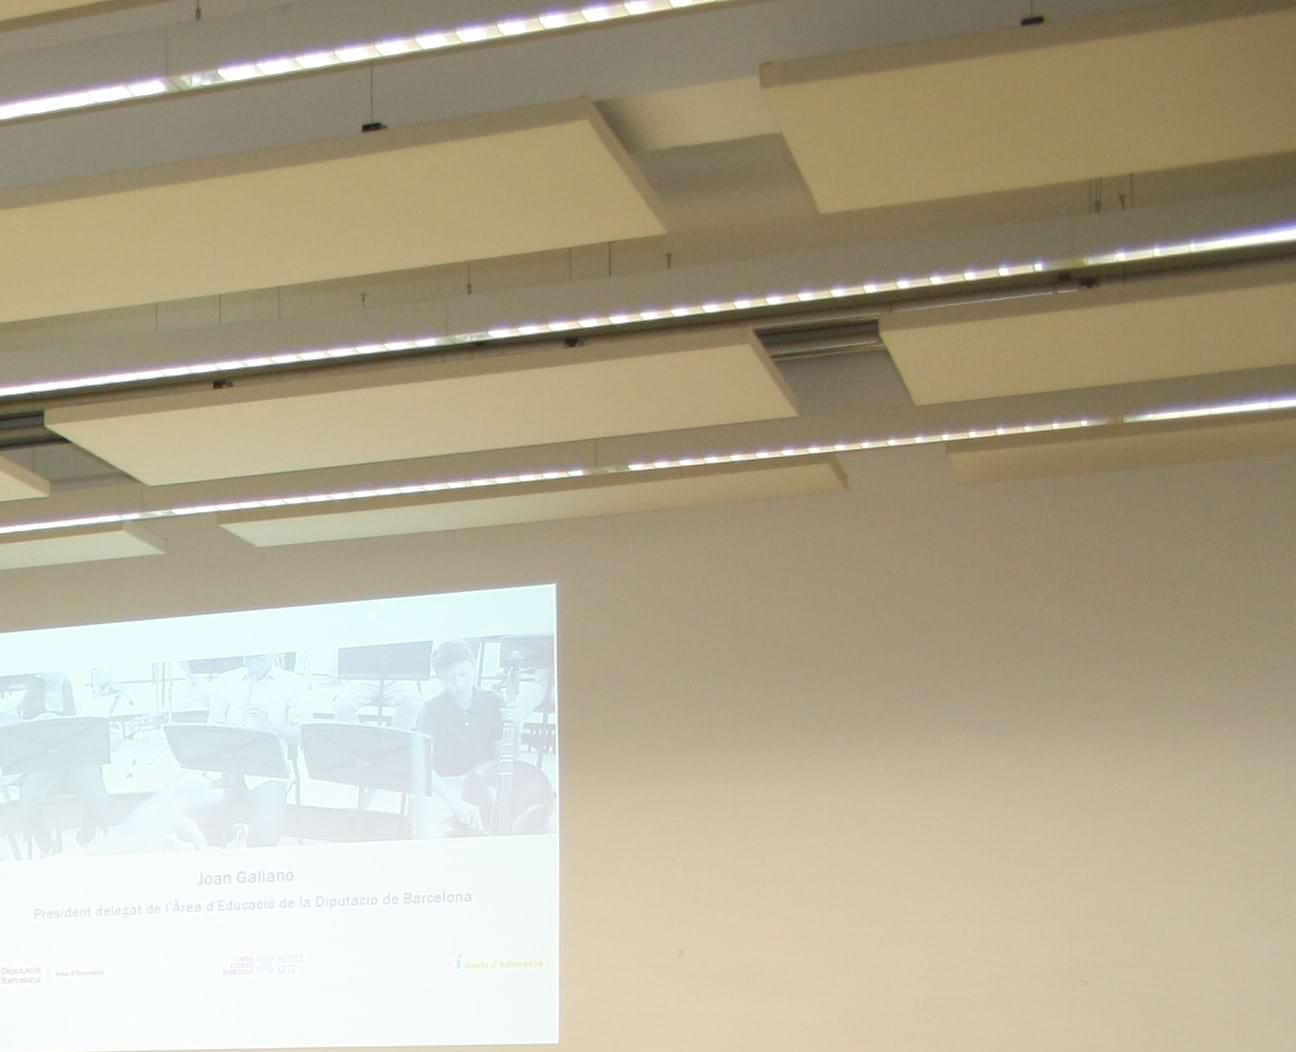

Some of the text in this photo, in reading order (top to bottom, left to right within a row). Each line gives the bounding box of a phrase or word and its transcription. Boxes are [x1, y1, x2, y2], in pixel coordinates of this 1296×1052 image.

[197, 870, 294, 886] Joan Galiano
[33, 906, 94, 919] President
[95, 904, 143, 919] delegat
[147, 903, 161, 914] de
[278, 896, 295, 908] de
[299, 896, 311, 908] la
[382, 892, 399, 905] de
[403, 890, 473, 904] Barcelona
